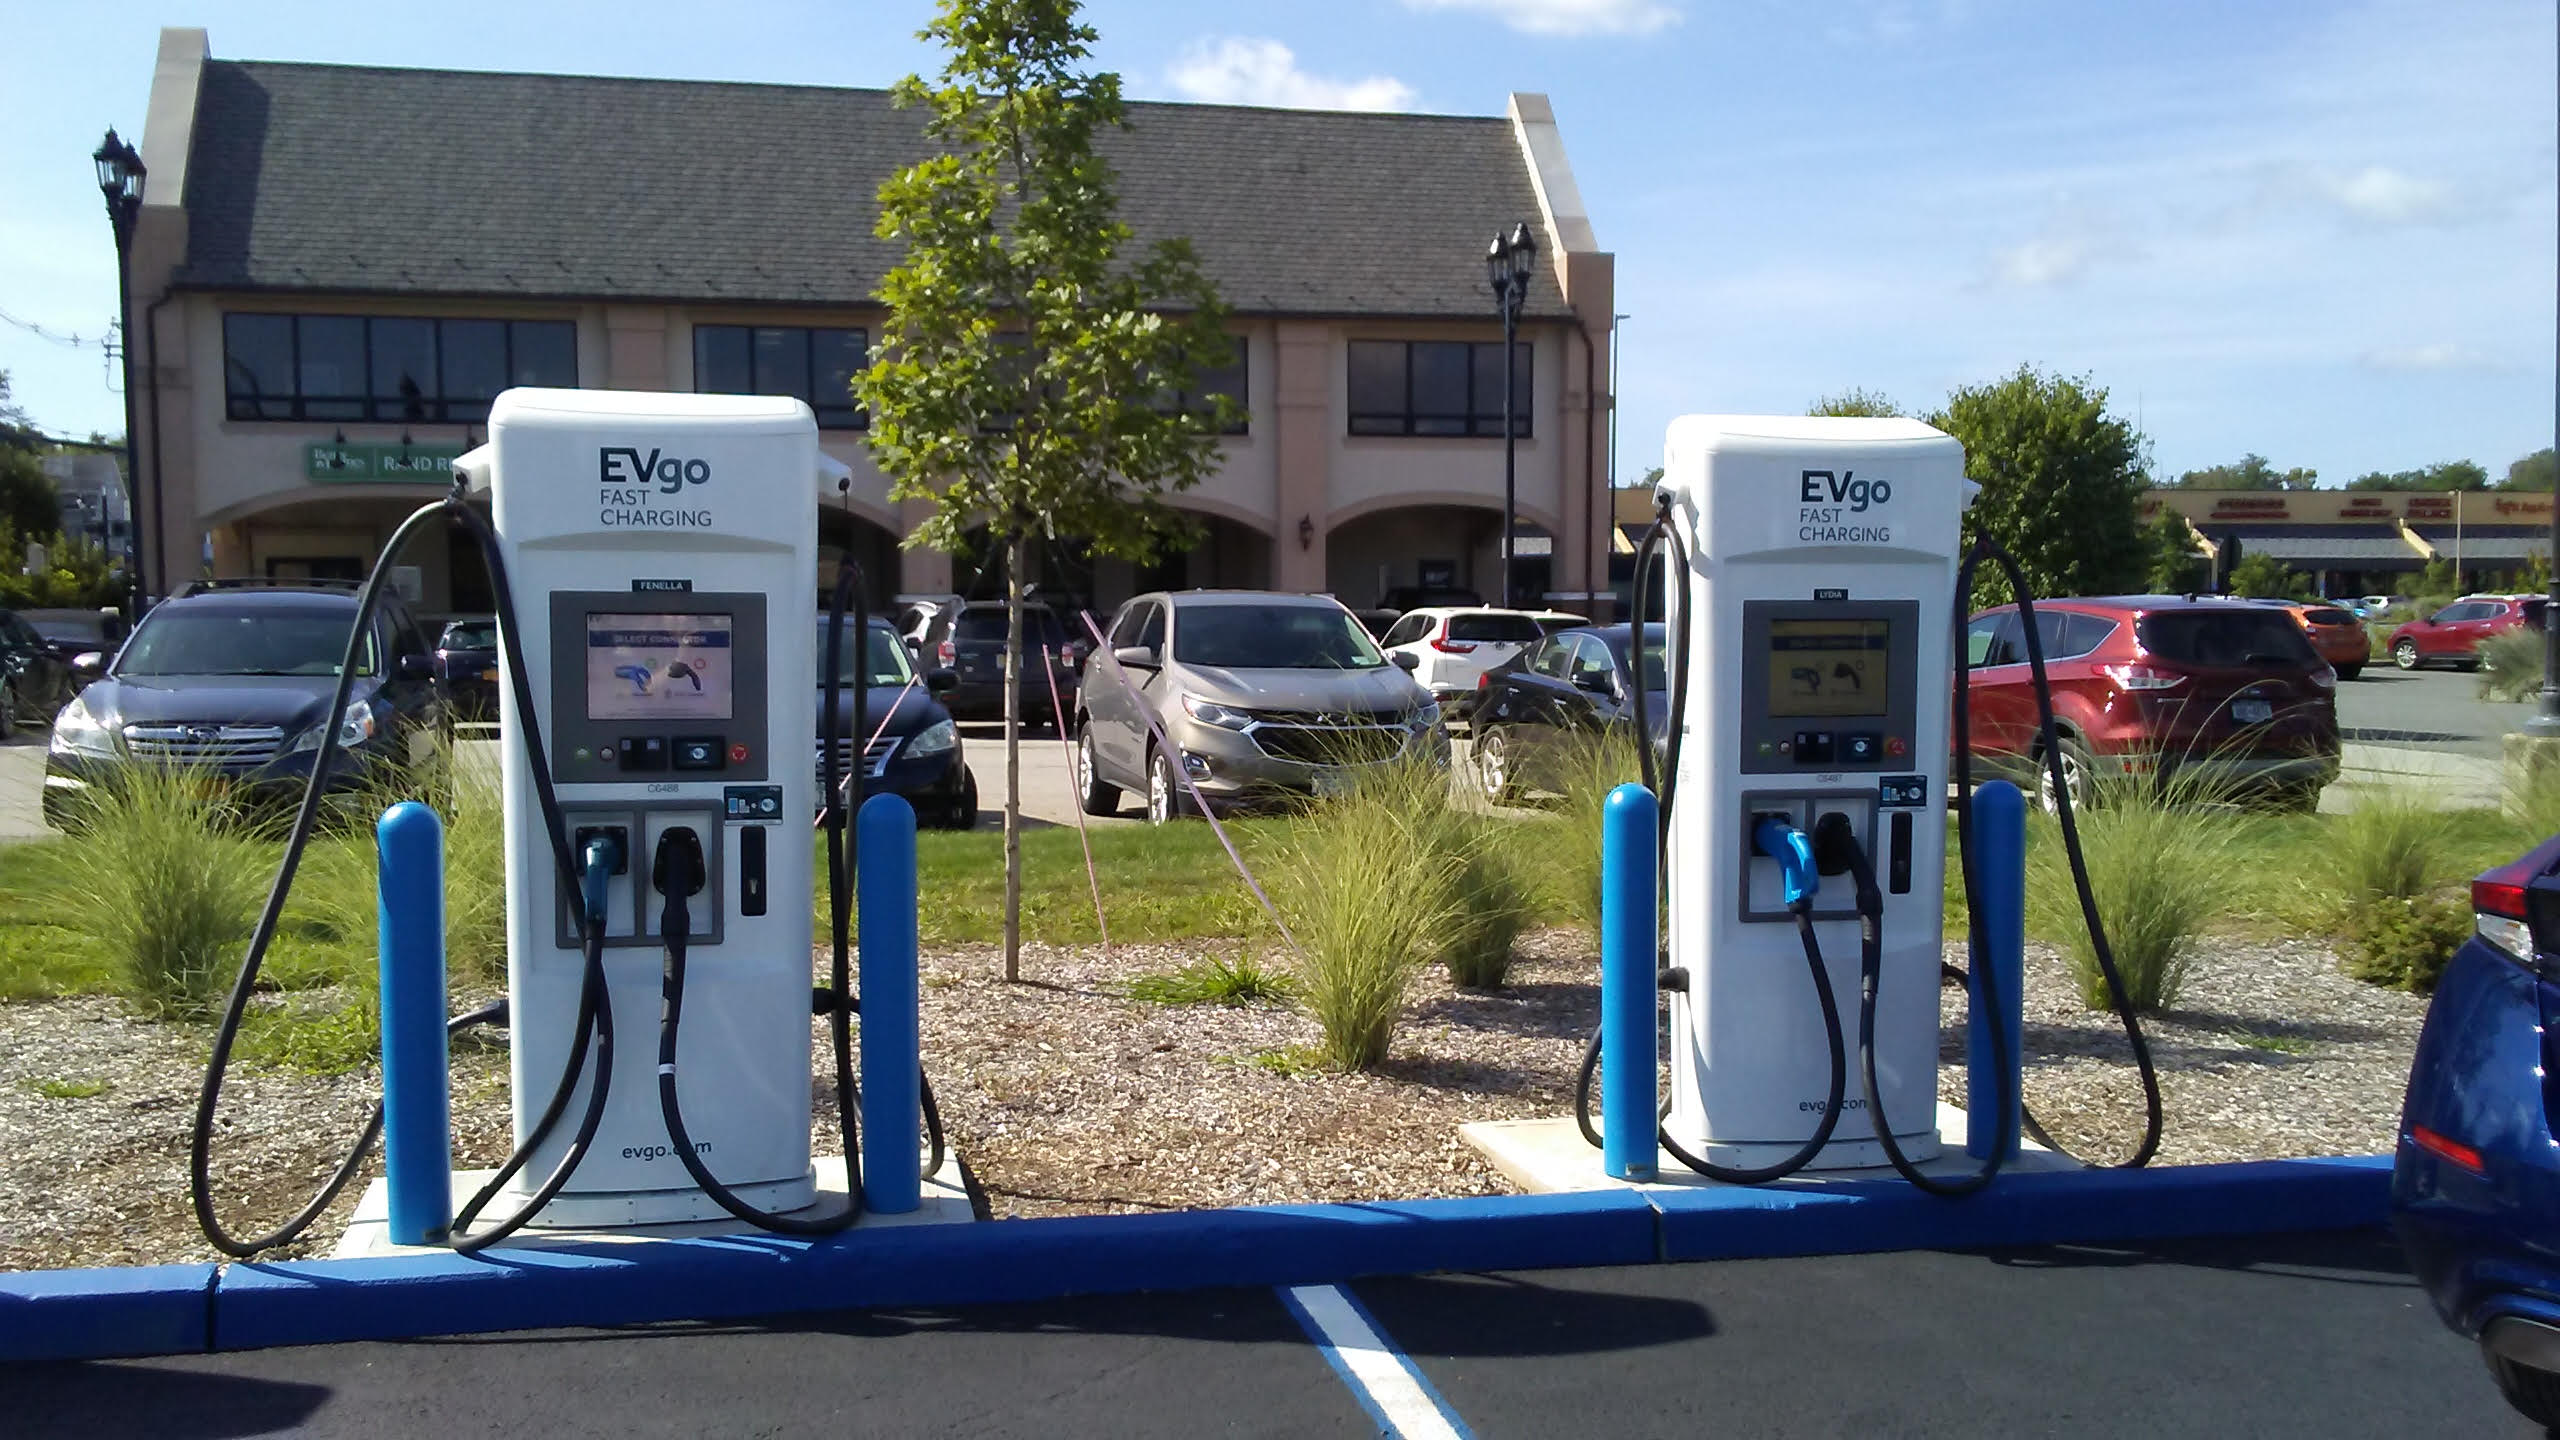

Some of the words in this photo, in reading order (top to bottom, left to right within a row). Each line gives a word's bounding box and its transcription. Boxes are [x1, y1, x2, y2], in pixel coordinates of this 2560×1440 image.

[600, 447, 711, 494] EVgo
[600, 489, 650, 506] FAST
[1801, 470, 1891, 512] EVgo
[600, 508, 712, 527] CHARGING
[1800, 508, 1842, 523] FAST
[1799, 526, 1890, 542] CHARGING
[640, 581, 684, 591] FENELLA
[1819, 590, 1842, 600] LYDIA
[622, 1142, 712, 1161] evgo.cm
